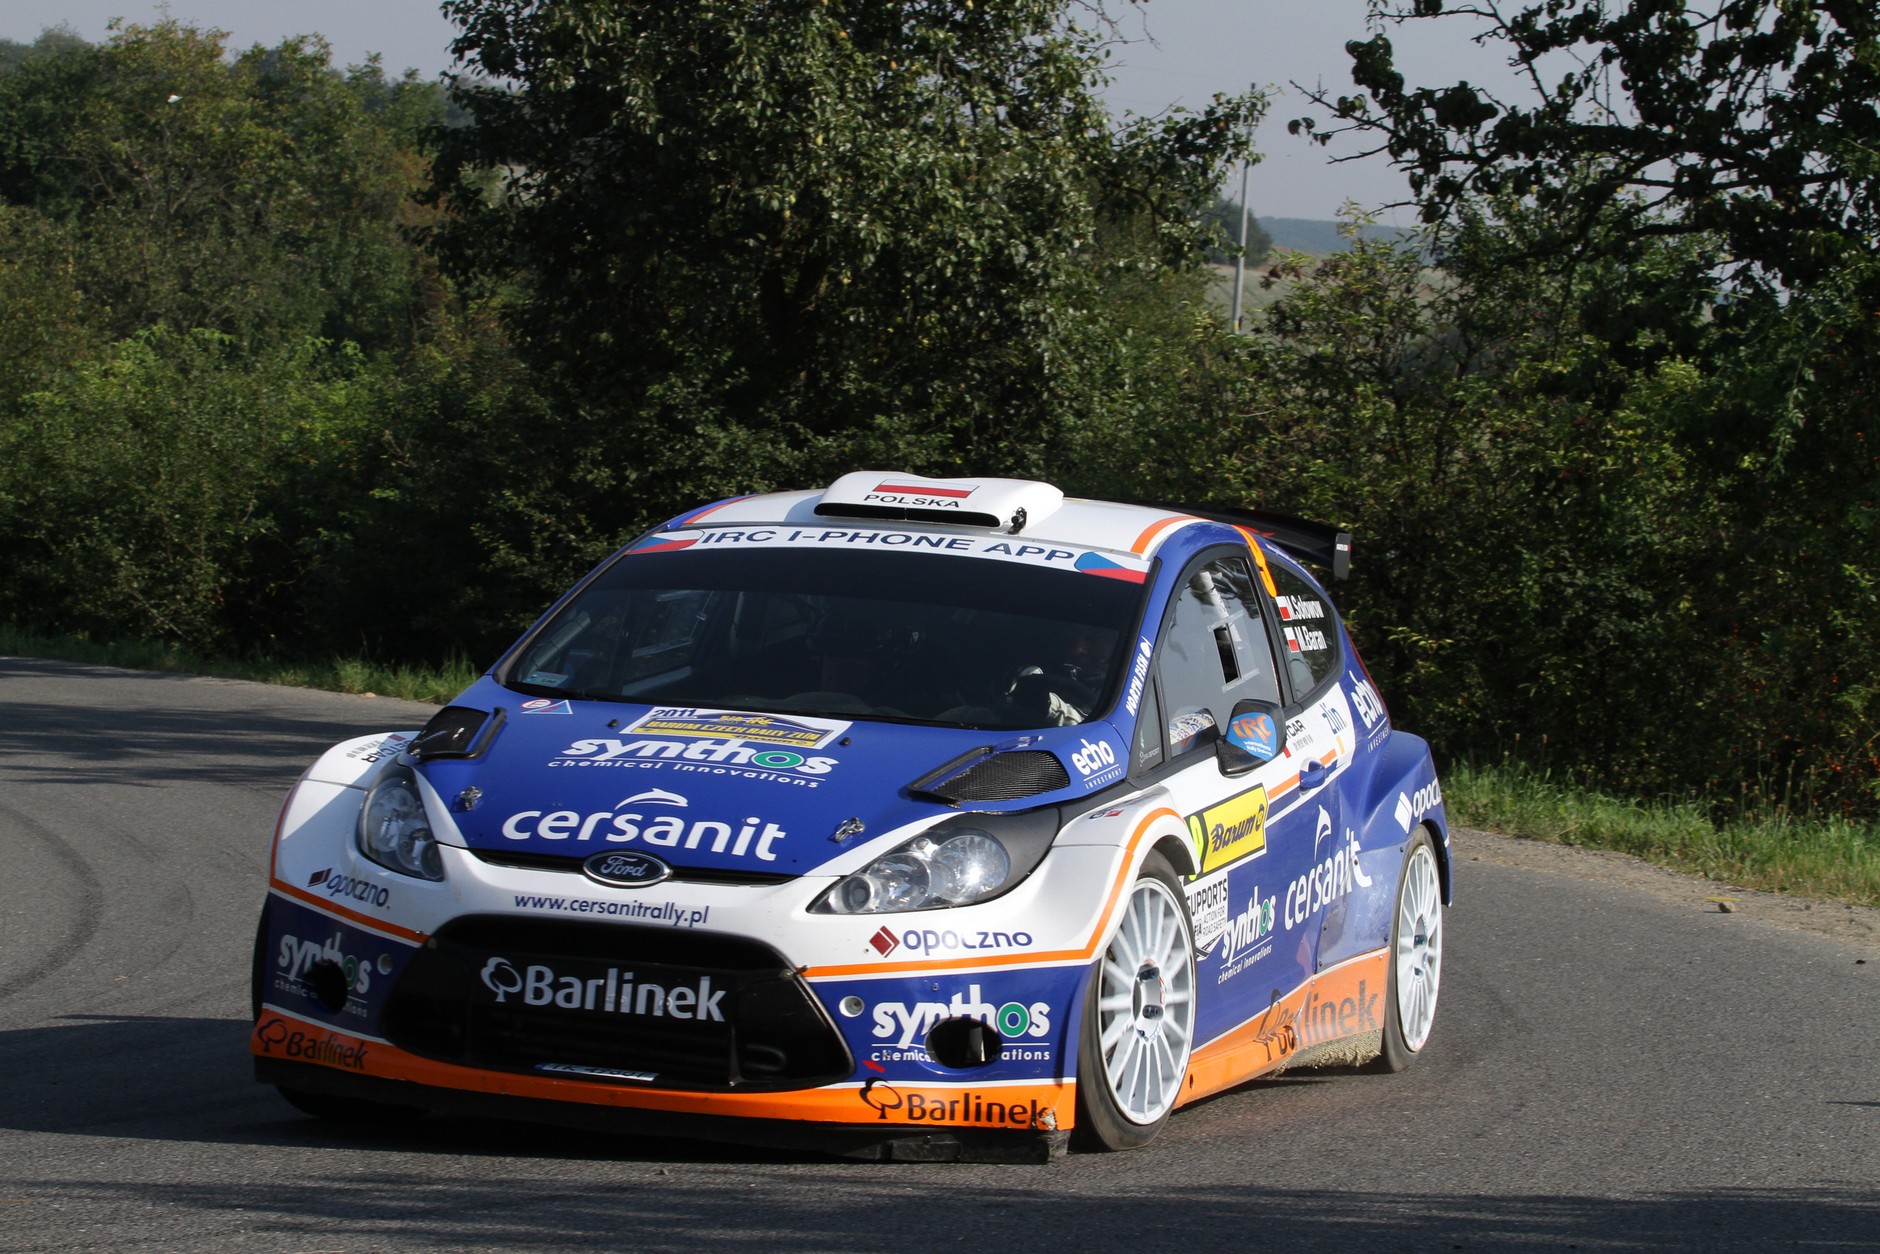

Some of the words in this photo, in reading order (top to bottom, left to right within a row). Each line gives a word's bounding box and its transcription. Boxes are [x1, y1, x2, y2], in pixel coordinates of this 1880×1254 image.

[863, 493, 961, 509] POLSKA
[702, 530, 777, 544] IRC
[787, 530, 975, 551] I-PHONE
[982, 543, 1075, 563] APP
[1125, 678, 1143, 717] NORTH
[1134, 653, 1150, 684] FISH
[645, 721, 698, 730] BARUM
[701, 724, 745, 733] CZECH
[748, 728, 788, 737] RALLY
[652, 708, 696, 718] 2011
[547, 760, 663, 771] chemical
[673, 763, 819, 788] innovations
[563, 739, 839, 775] synthos
[1071, 739, 1115, 775] echo
[1085, 768, 1122, 789] INVESTMENT
[502, 810, 787, 861] cersanit
[1210, 814, 1257, 853] Barum
[601, 855, 646, 877] Ford
[1284, 827, 1373, 930] cersanit
[514, 893, 710, 928] www.cersanitrally.pl
[1221, 885, 1277, 968] synthos
[902, 929, 1033, 956] opoczno
[277, 931, 372, 994] synthos
[1218, 960, 1242, 984] chemical
[1242, 944, 1273, 973] innovations
[274, 977, 318, 999] chemica
[523, 965, 728, 1022] Barlinek
[872, 984, 1051, 1050] synthos
[1271, 979, 1378, 1055] Barlinek
[286, 1031, 369, 1070] Barlinek
[871, 1049, 936, 1063] chemica
[1001, 1049, 1051, 1062] ations
[907, 1092, 1053, 1129] Barlinek
